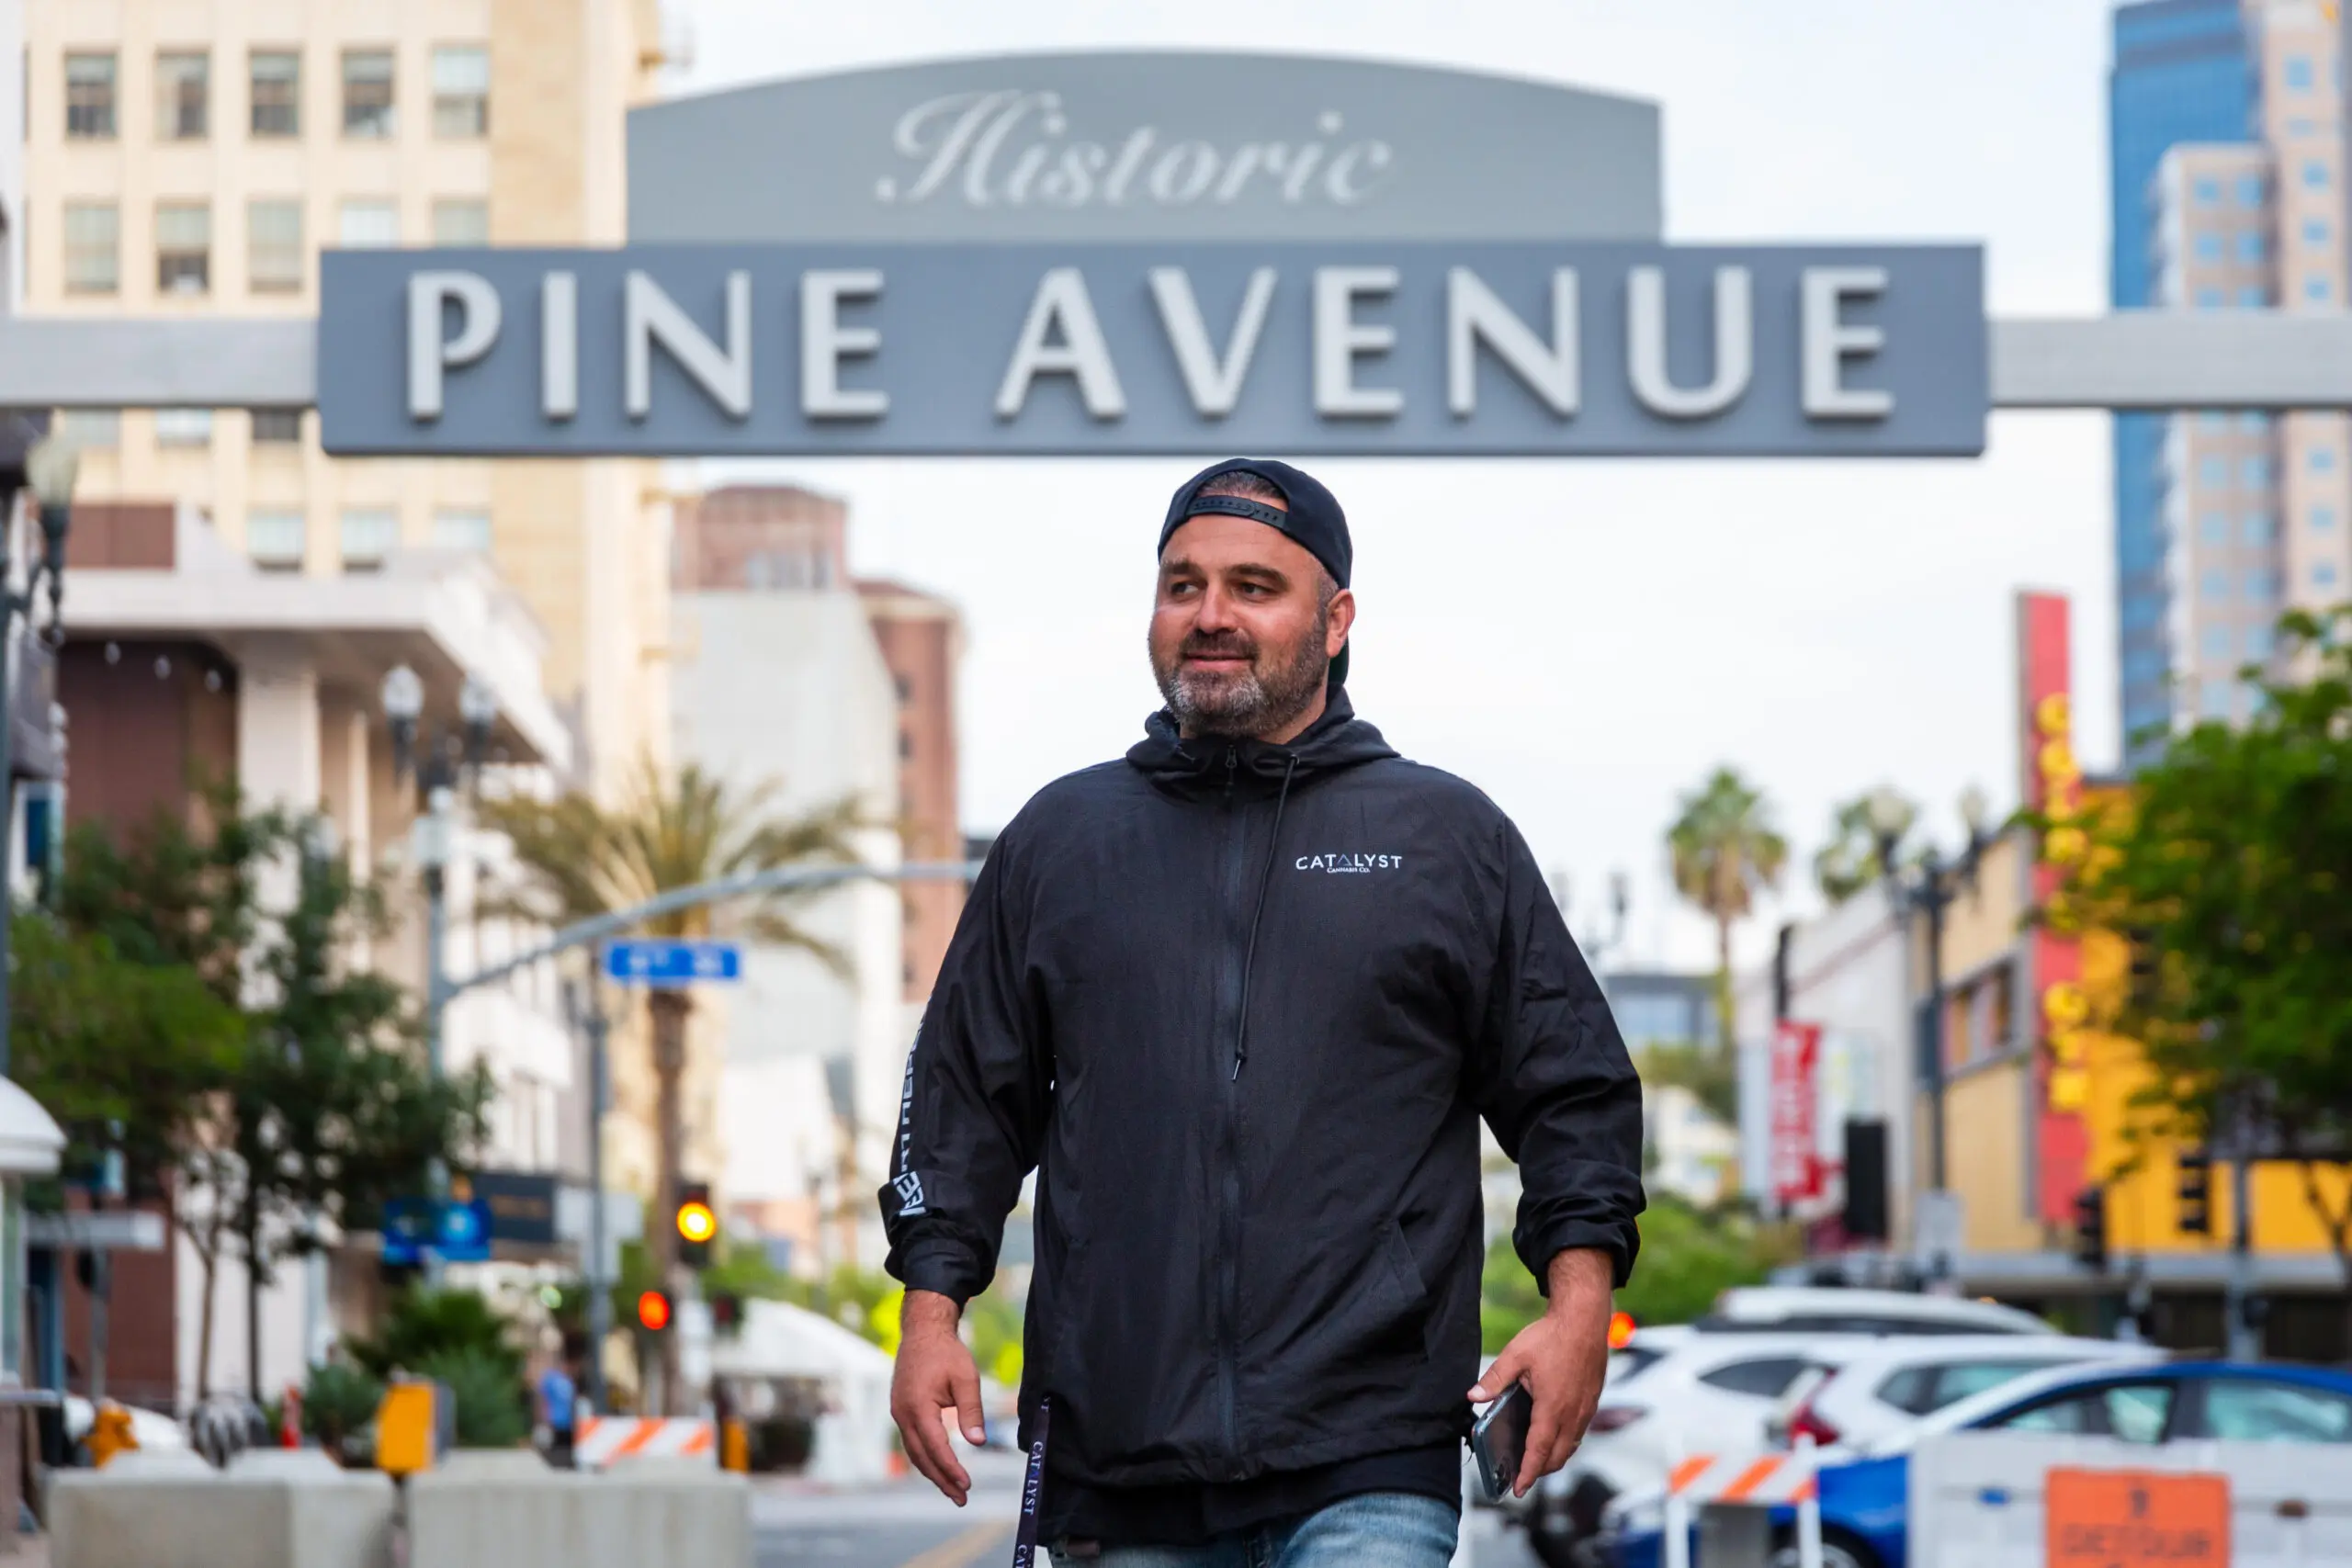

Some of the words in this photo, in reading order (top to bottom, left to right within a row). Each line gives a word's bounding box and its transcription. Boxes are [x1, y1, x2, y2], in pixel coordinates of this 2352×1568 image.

[876, 89, 1393, 206] Historic
[407, 267, 891, 420] PINE
[994, 265, 1896, 420] AVENUE
